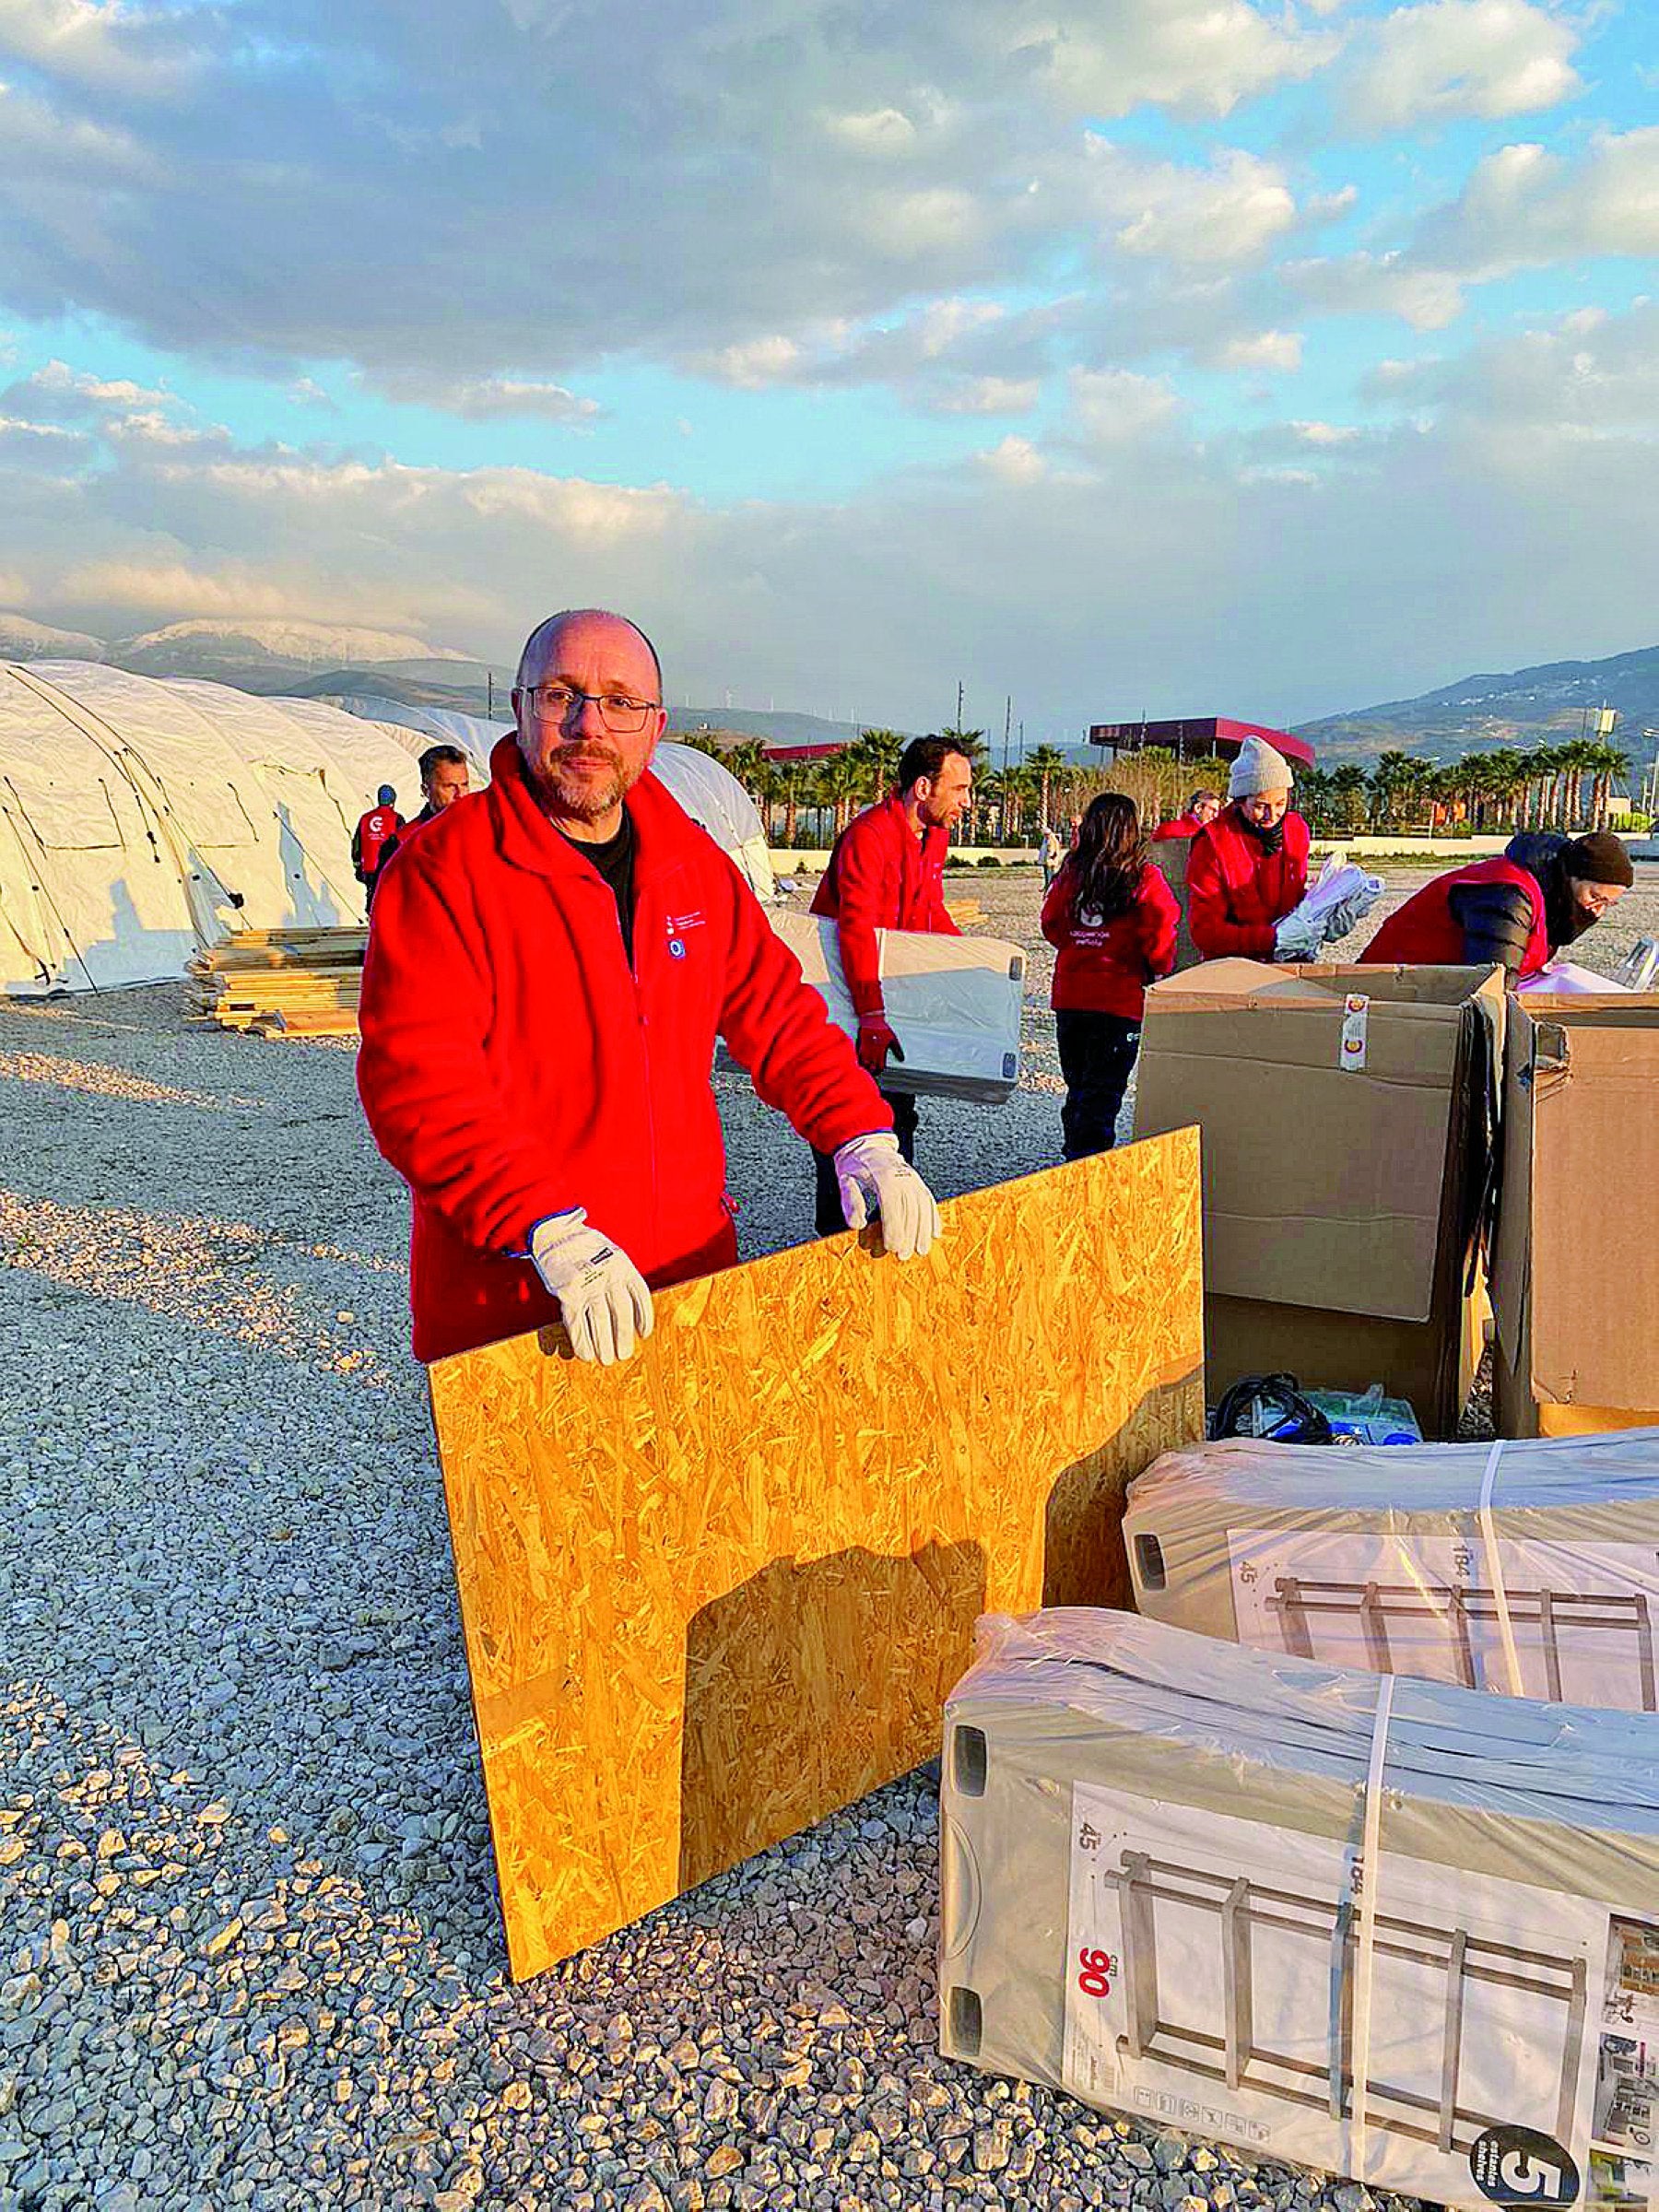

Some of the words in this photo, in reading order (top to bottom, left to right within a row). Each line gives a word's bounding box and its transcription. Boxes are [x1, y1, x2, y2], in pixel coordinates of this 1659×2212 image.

[1240, 1561, 1255, 1583] 45
[1453, 1546, 1470, 1577] 184
[1079, 1822, 1096, 1850] 45
[1078, 1947, 1110, 1998] 90
[1476, 2139, 1488, 2182] shelves
[1487, 2139, 1500, 2187] estantes
[1500, 2150, 1562, 2199] 5
